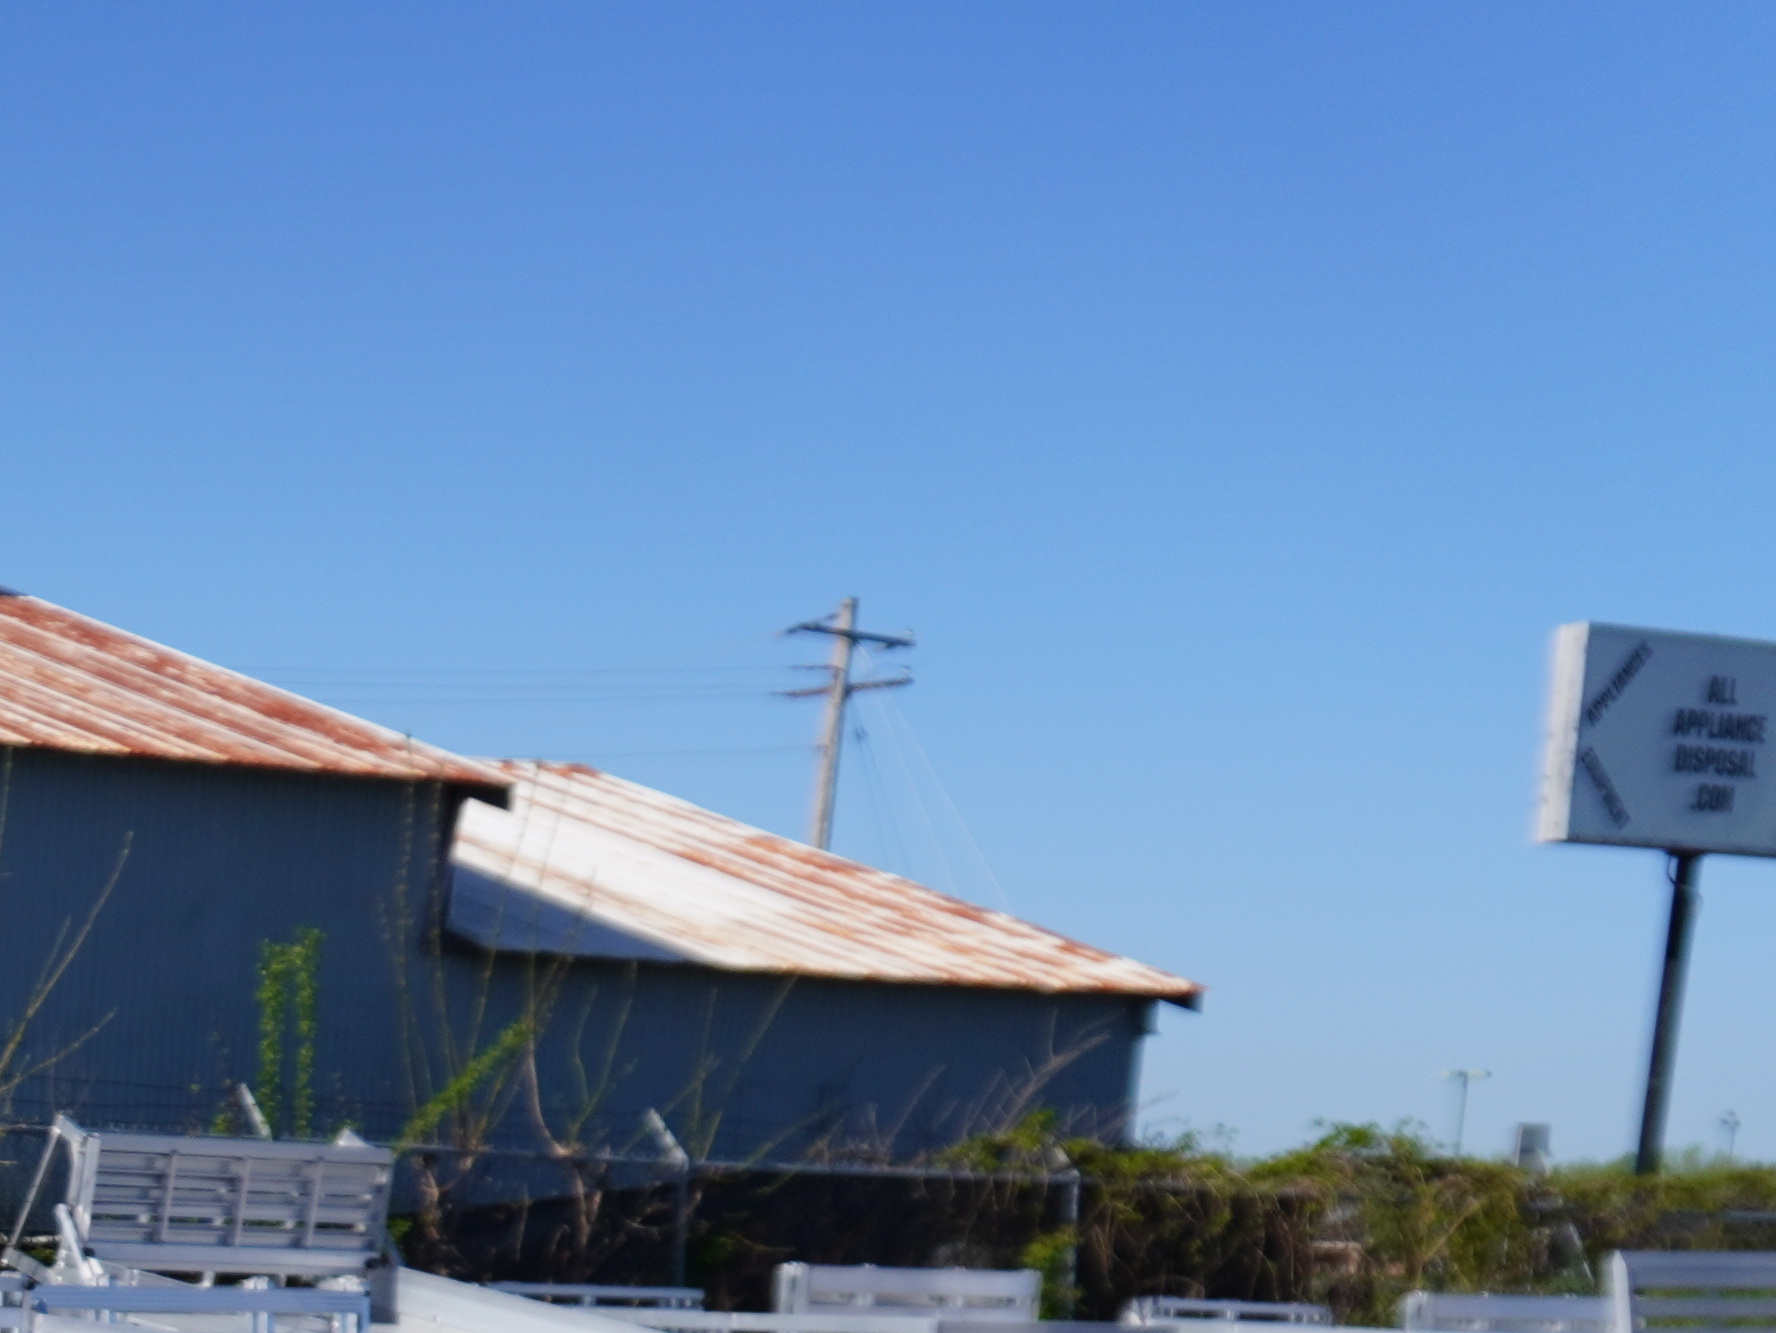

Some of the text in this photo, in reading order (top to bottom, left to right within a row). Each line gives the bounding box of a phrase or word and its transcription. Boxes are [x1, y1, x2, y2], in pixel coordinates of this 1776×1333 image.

[1707, 674, 1738, 705] ALL
[1672, 707, 1767, 744] APPLIANCE
[1673, 743, 1757, 779] DISPOSAL
